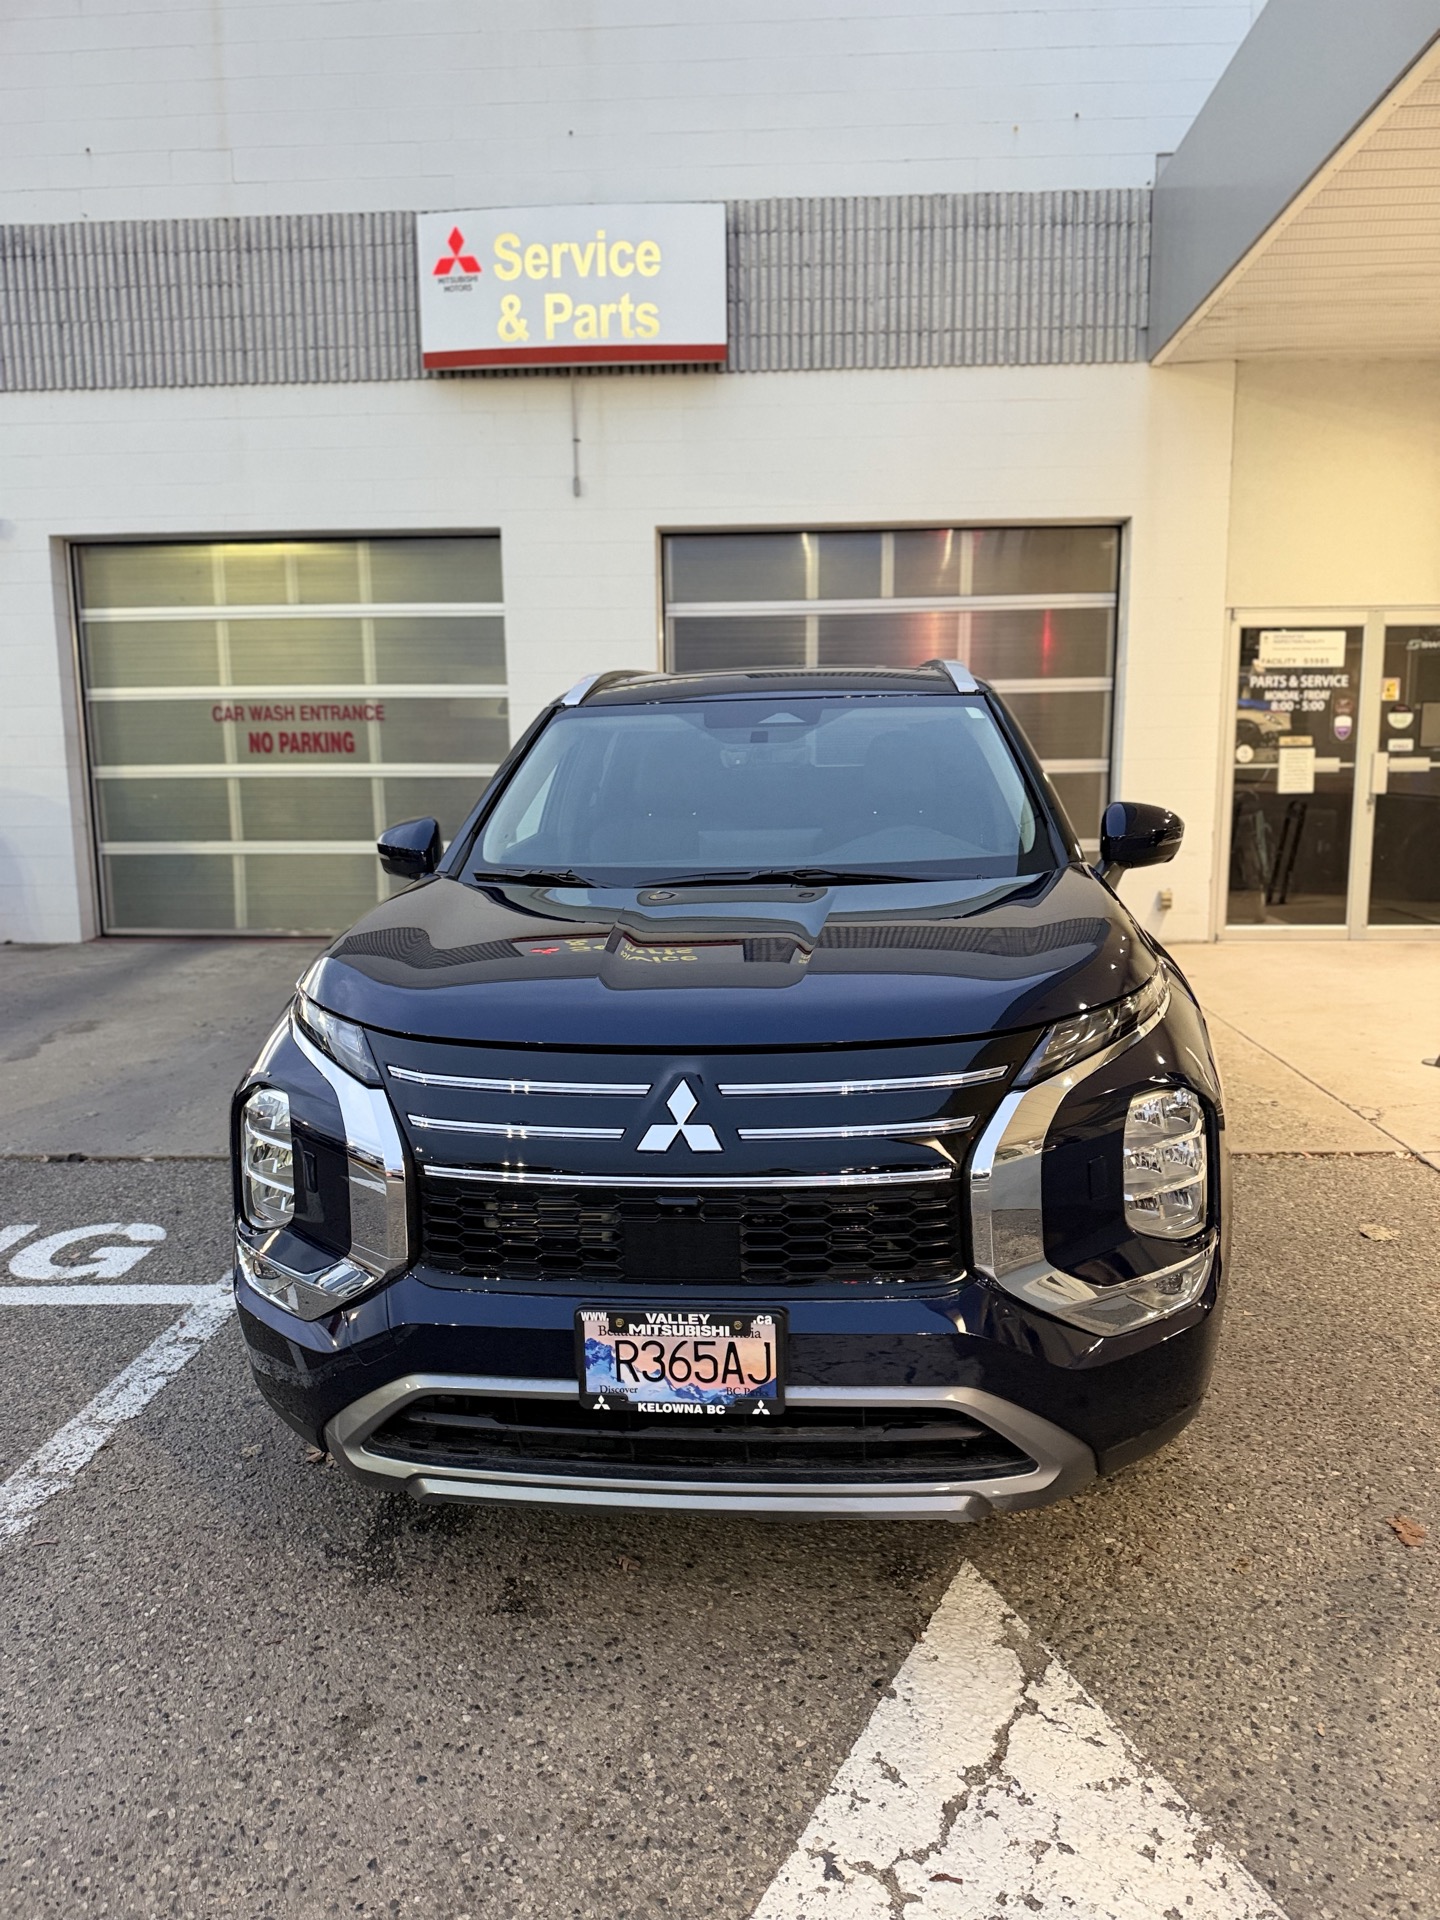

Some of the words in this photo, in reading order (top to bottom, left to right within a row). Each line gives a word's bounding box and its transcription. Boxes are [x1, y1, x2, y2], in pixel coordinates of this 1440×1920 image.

[493, 229, 662, 281] Service
[438, 275, 479, 284] MITSUBISHI
[443, 284, 473, 292] MOTORS
[497, 293, 530, 342] &
[544, 292, 660, 340] Parts
[1249, 675, 1287, 688] PARTS
[1288, 675, 1299, 688] &
[1300, 674, 1349, 687] SERVICE
[1270, 701, 1294, 711] 8:00
[1301, 701, 1325, 712] 5:00
[212, 705, 245, 722] CAR
[249, 705, 295, 721] WASH
[300, 704, 385, 721] ENTRANCE
[249, 732, 273, 753] NO
[279, 732, 355, 753] PARKING
[645, 1313, 710, 1325] VALLEY
[753, 1315, 773, 1325] .ca
[628, 1324, 731, 1337] MITSUBISHI
[614, 1340, 771, 1385] R365AJ
[599, 1385, 638, 1394] Discover
[726, 1387, 741, 1396] BC
[637, 1403, 703, 1414] KELOWNA
[706, 1404, 726, 1415] BC
